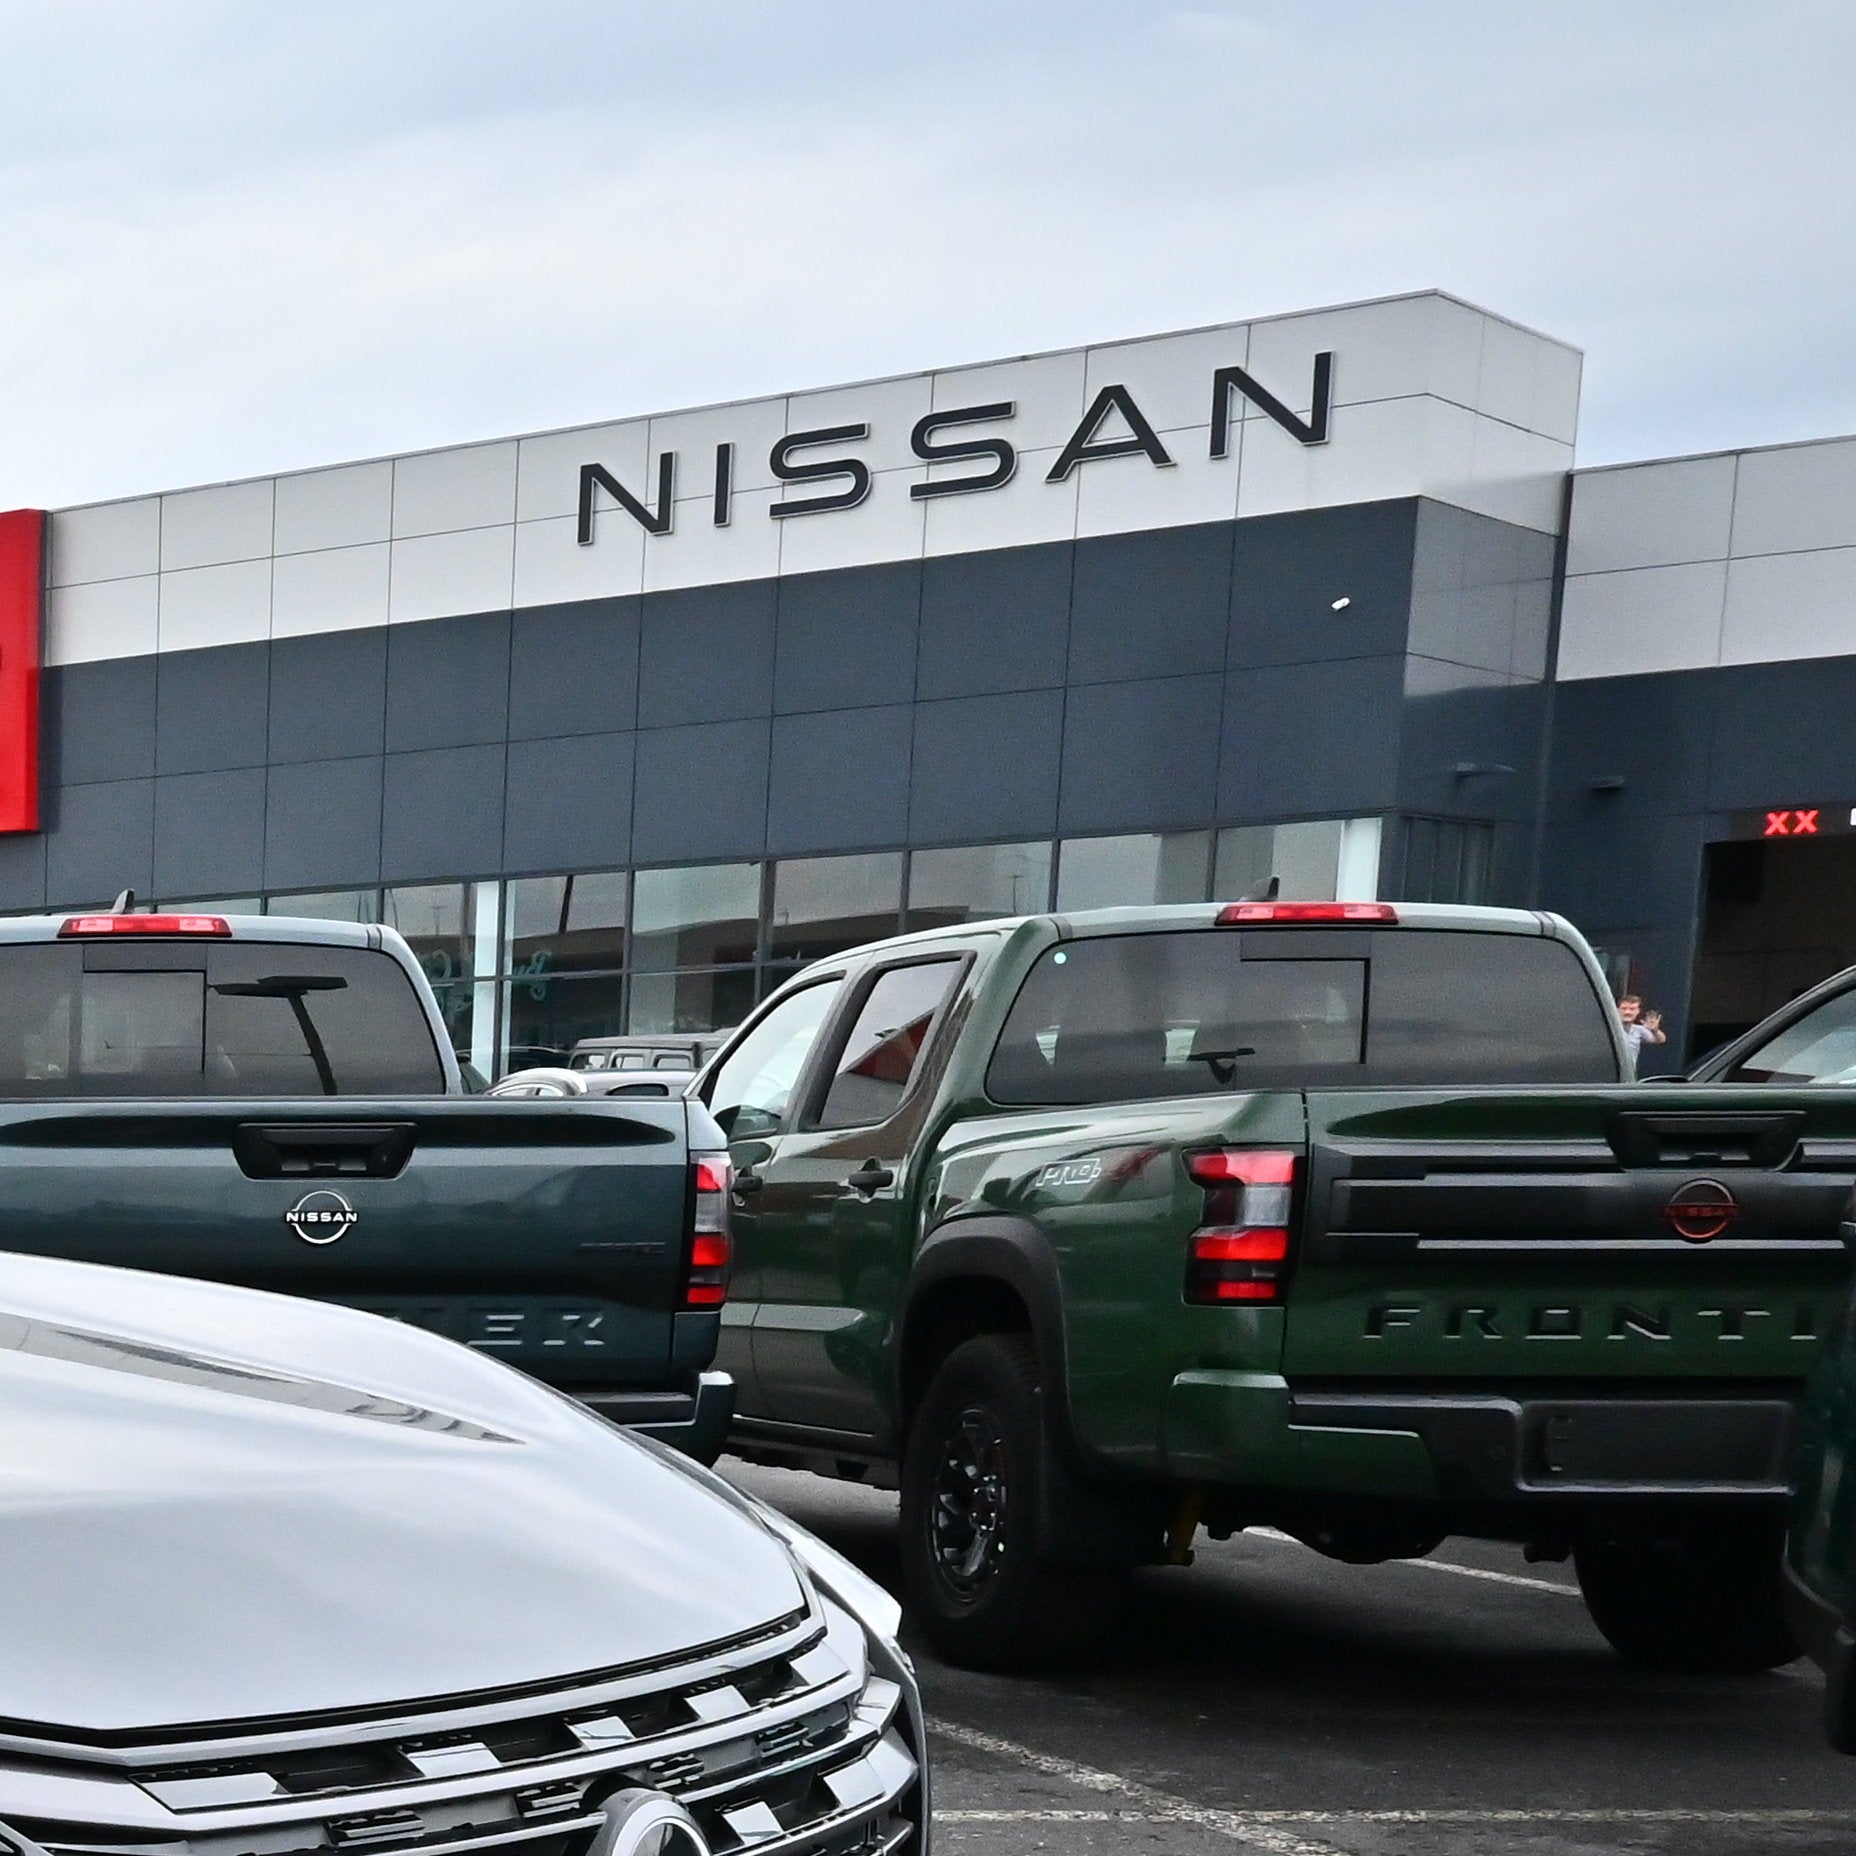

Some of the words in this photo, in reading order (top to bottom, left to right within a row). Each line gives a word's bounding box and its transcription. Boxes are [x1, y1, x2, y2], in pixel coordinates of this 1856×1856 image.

[577, 351, 1336, 547] NISSAN
[286, 1211, 358, 1223] NISSAN
[1363, 1306, 1818, 1341] FRONTI
